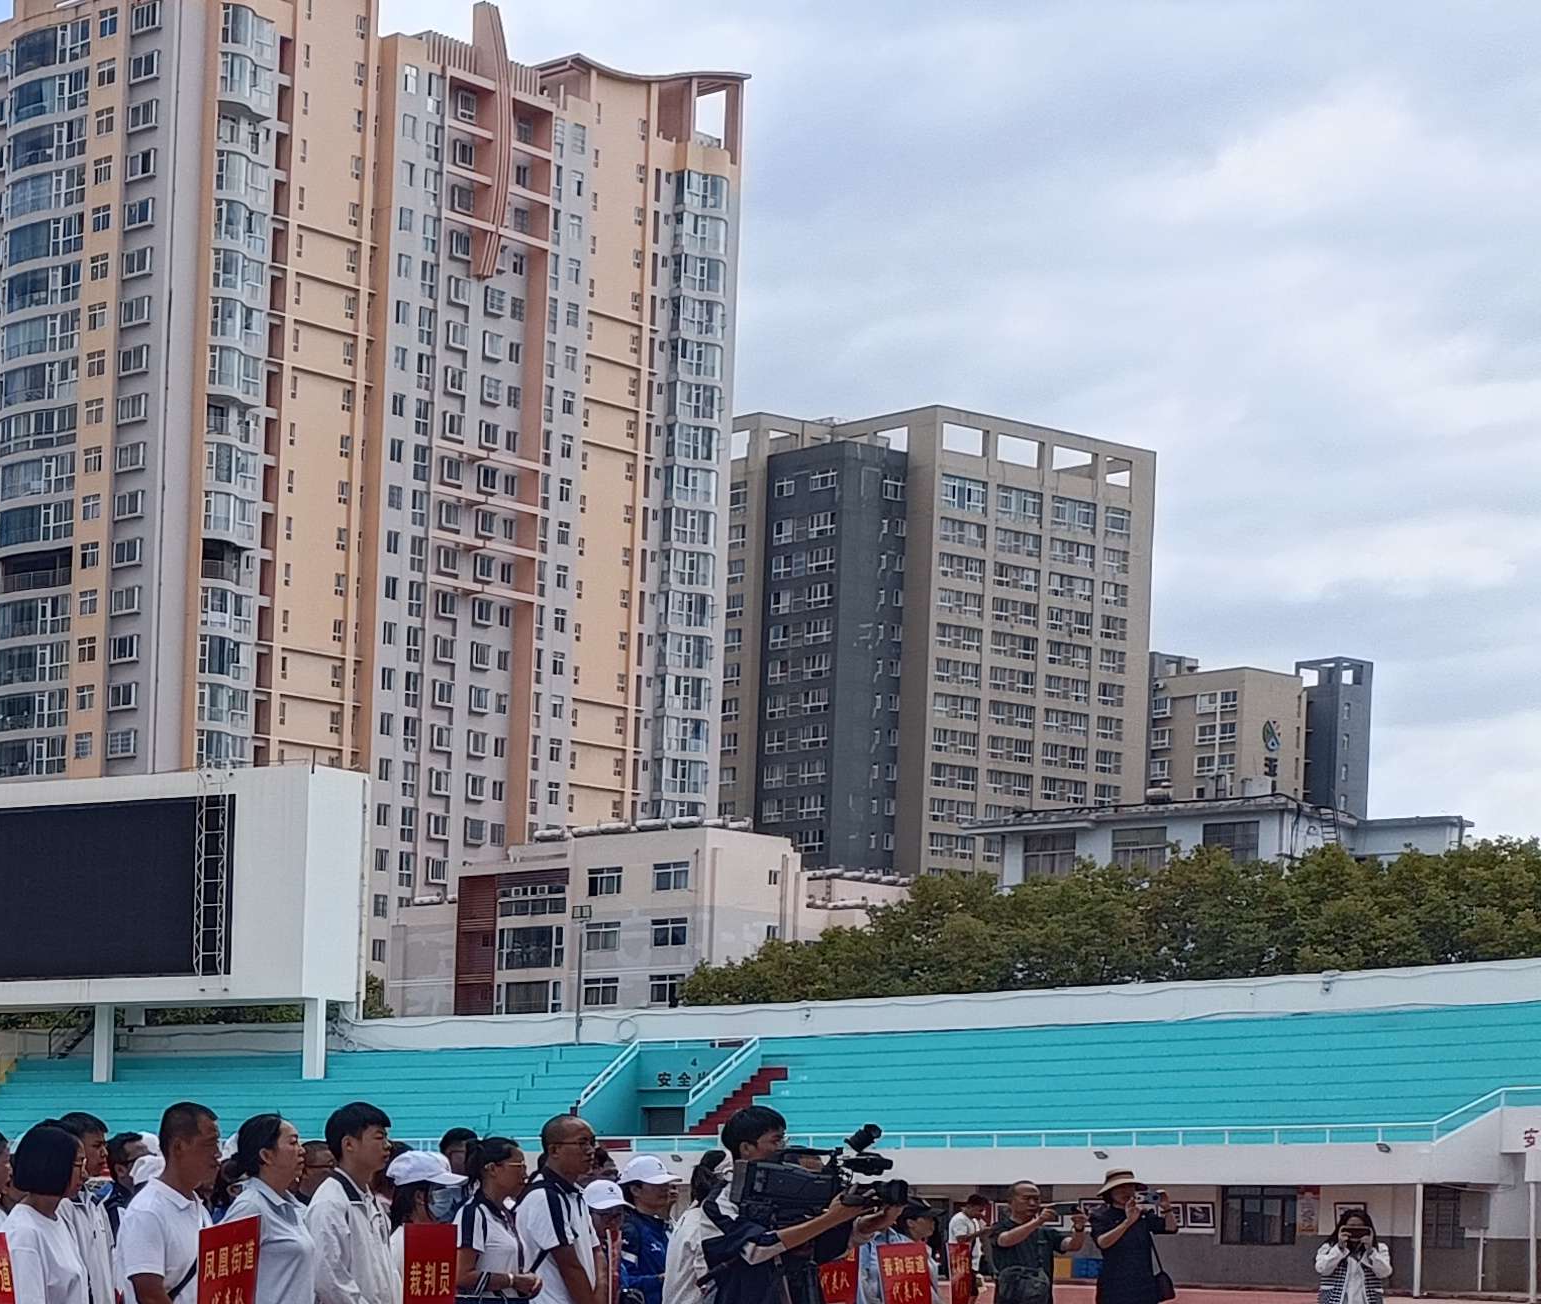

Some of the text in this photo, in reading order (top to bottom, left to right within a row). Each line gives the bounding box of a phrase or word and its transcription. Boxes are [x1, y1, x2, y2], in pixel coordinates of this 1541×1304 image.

[1523, 1128, 1539, 1148] 安
[203, 1239, 255, 1282] 凤凰街道
[409, 1261, 450, 1297] 裁判员
